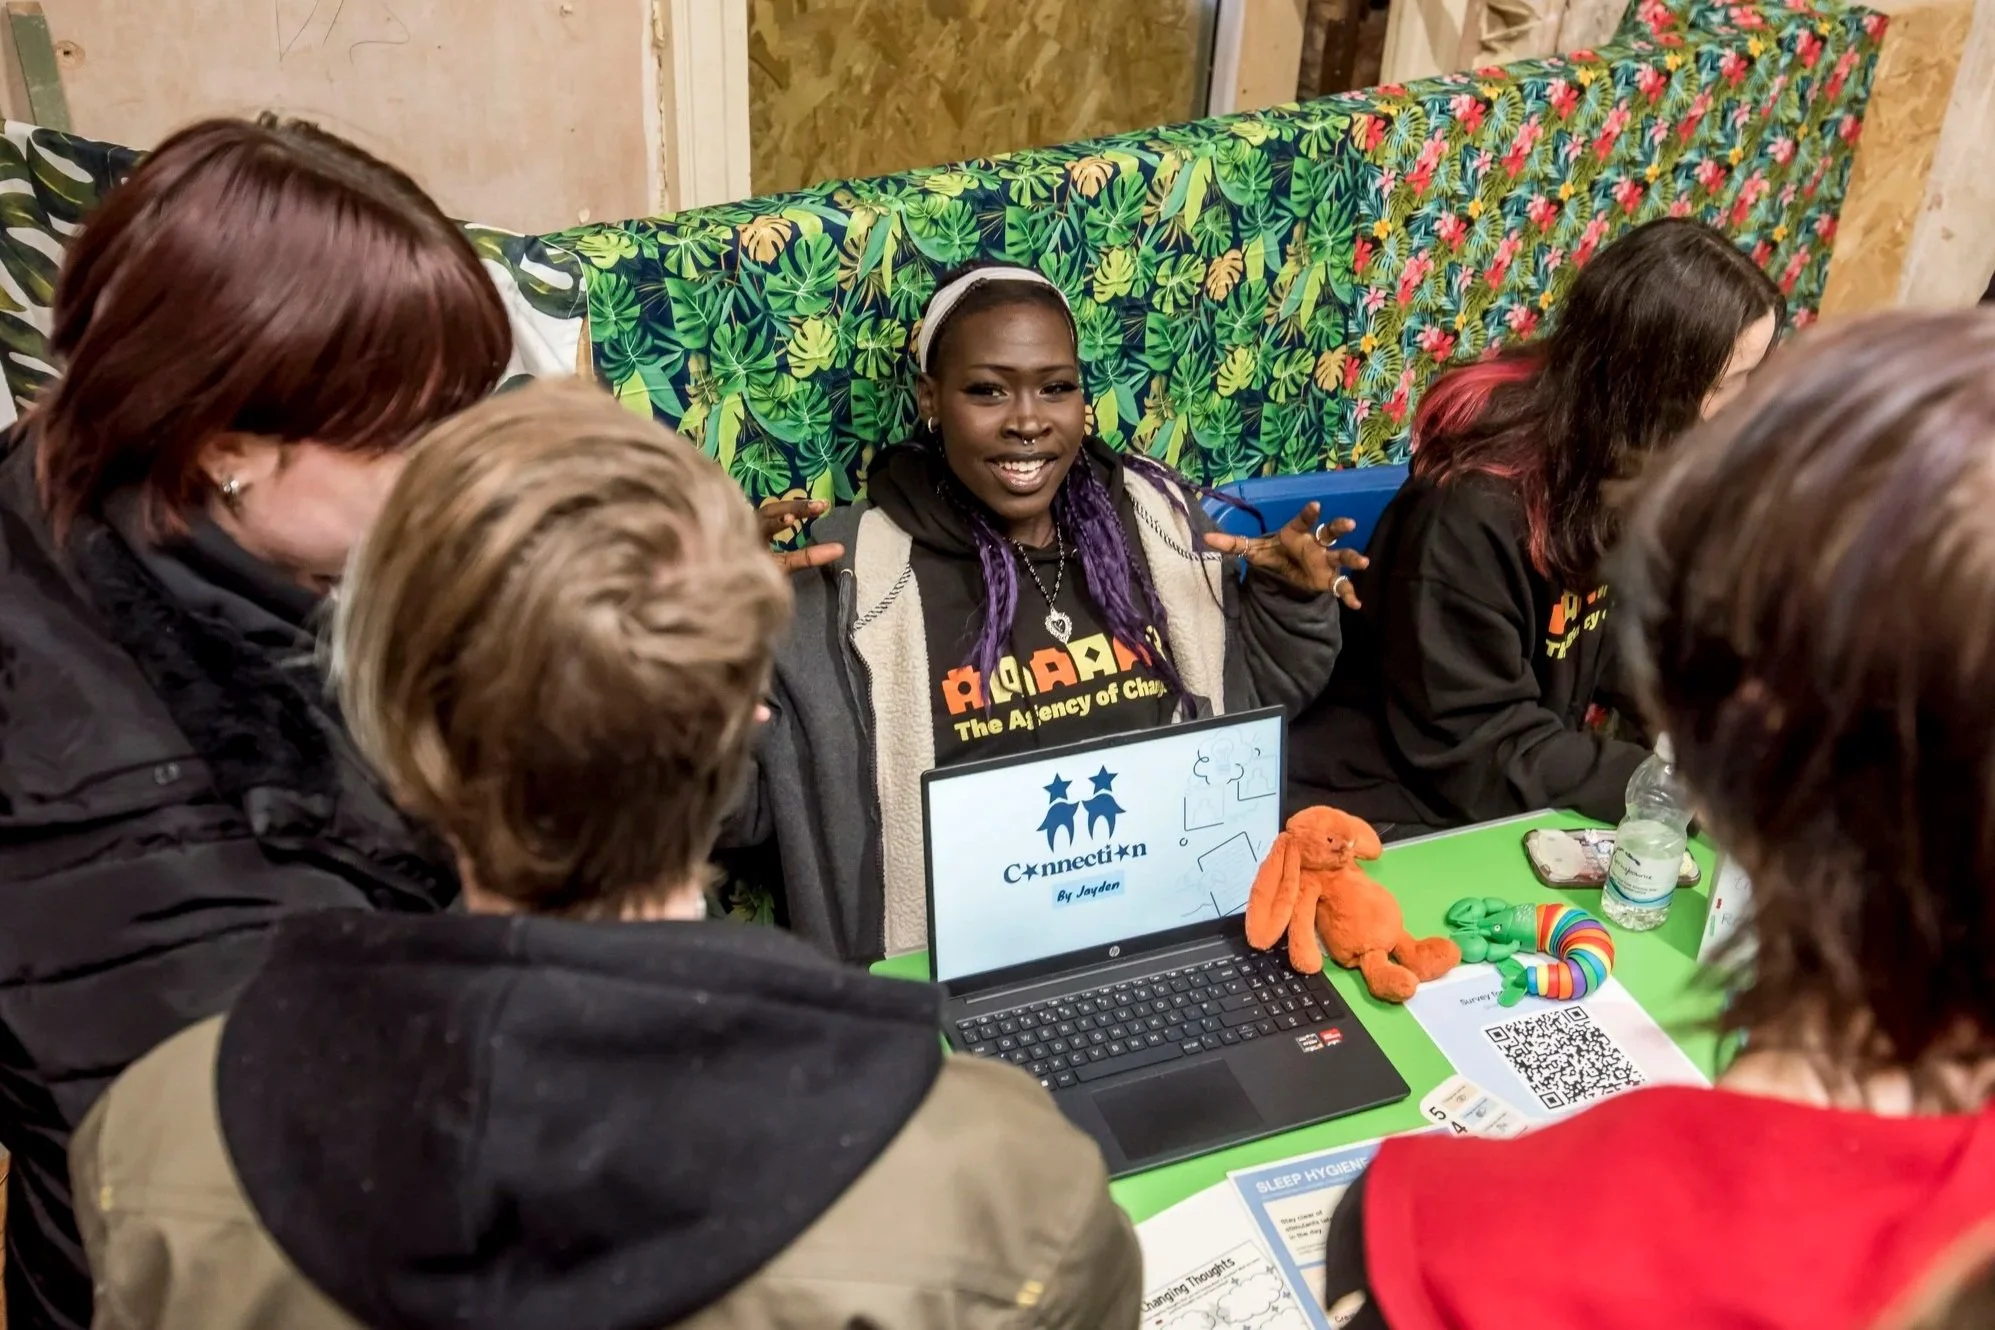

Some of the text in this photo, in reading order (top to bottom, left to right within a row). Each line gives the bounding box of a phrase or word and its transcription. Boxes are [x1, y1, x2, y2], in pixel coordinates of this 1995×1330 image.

[953, 717, 1003, 742] The
[1095, 684, 1119, 706] of
[1057, 880, 1120, 903] By Jayden
[1460, 993, 1490, 1005] Survey
[1429, 1106, 1447, 1120] 5
[1451, 1121, 1468, 1134] 4
[1256, 1172, 1302, 1194] SLEEP
[1186, 1258, 1235, 1288] Thoughts
